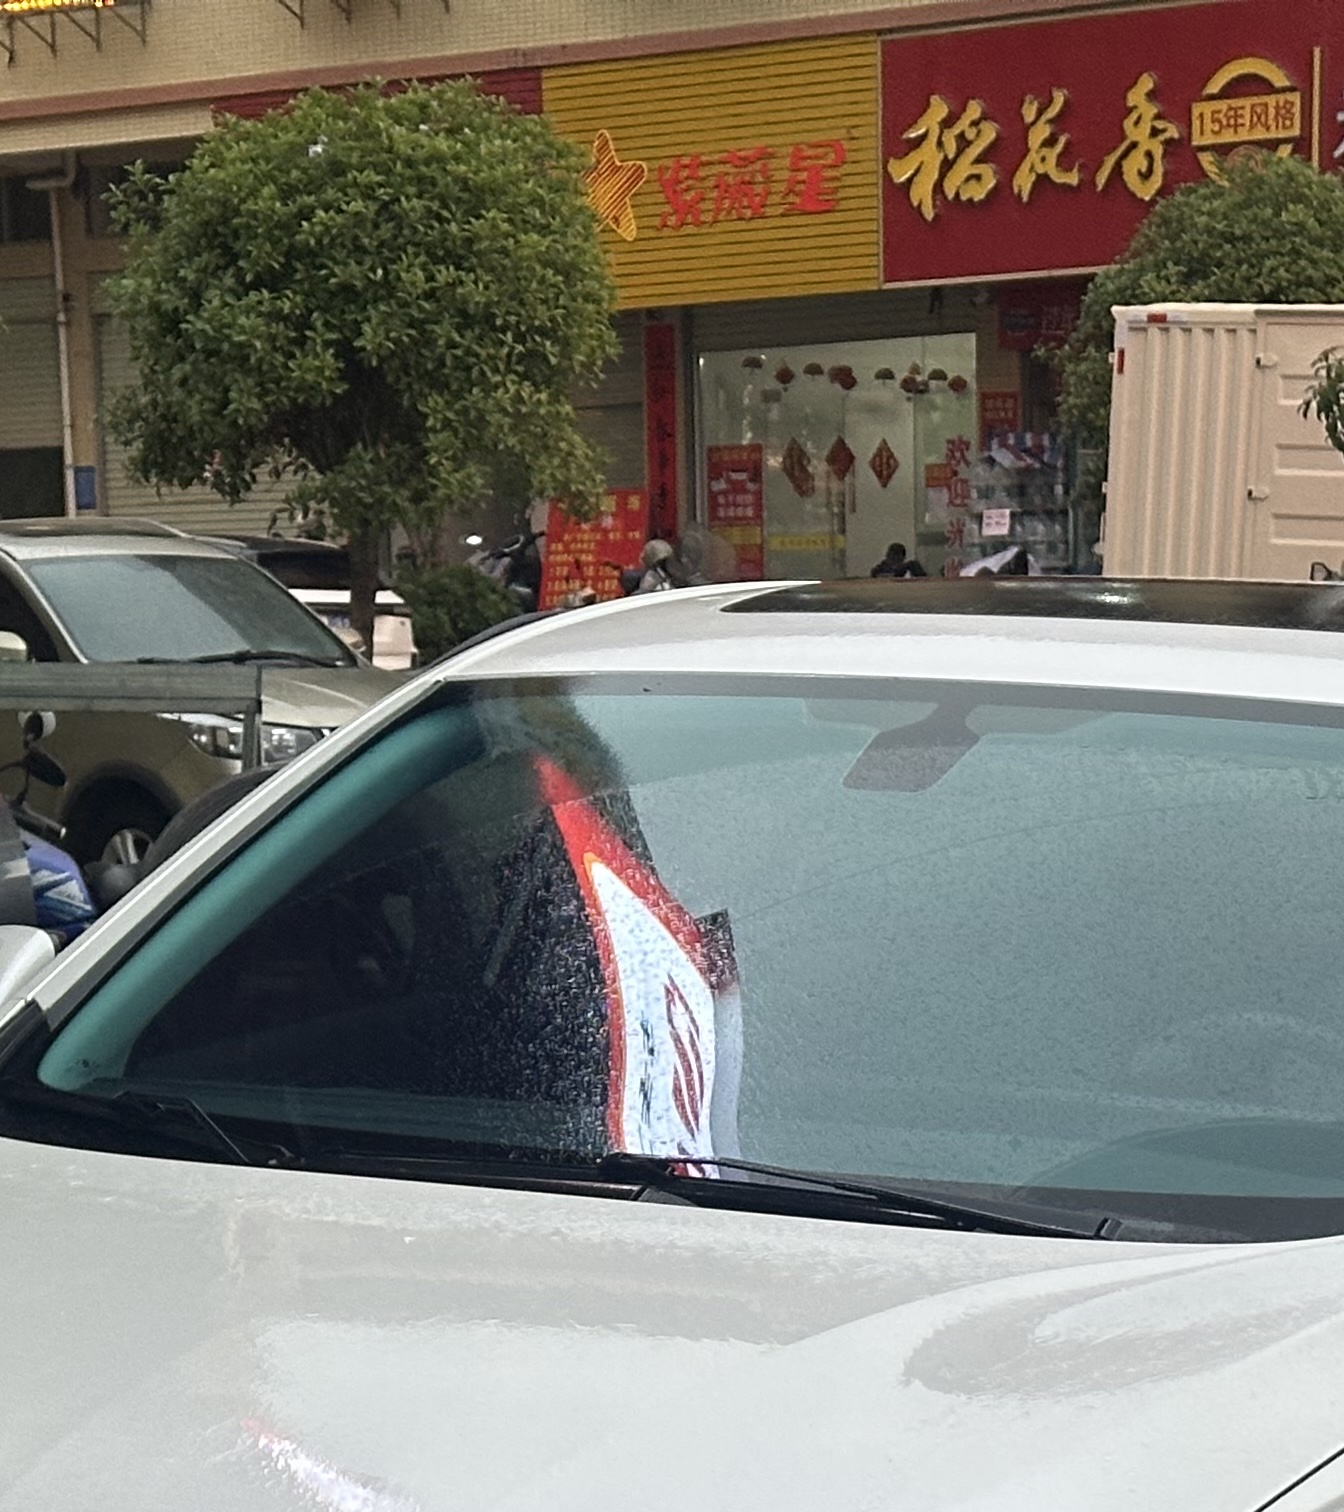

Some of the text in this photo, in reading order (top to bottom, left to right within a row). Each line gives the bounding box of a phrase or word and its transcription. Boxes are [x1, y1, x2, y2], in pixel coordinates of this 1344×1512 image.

[887, 72, 1181, 220] 稻花香
[1196, 99, 1296, 136] 15年风格
